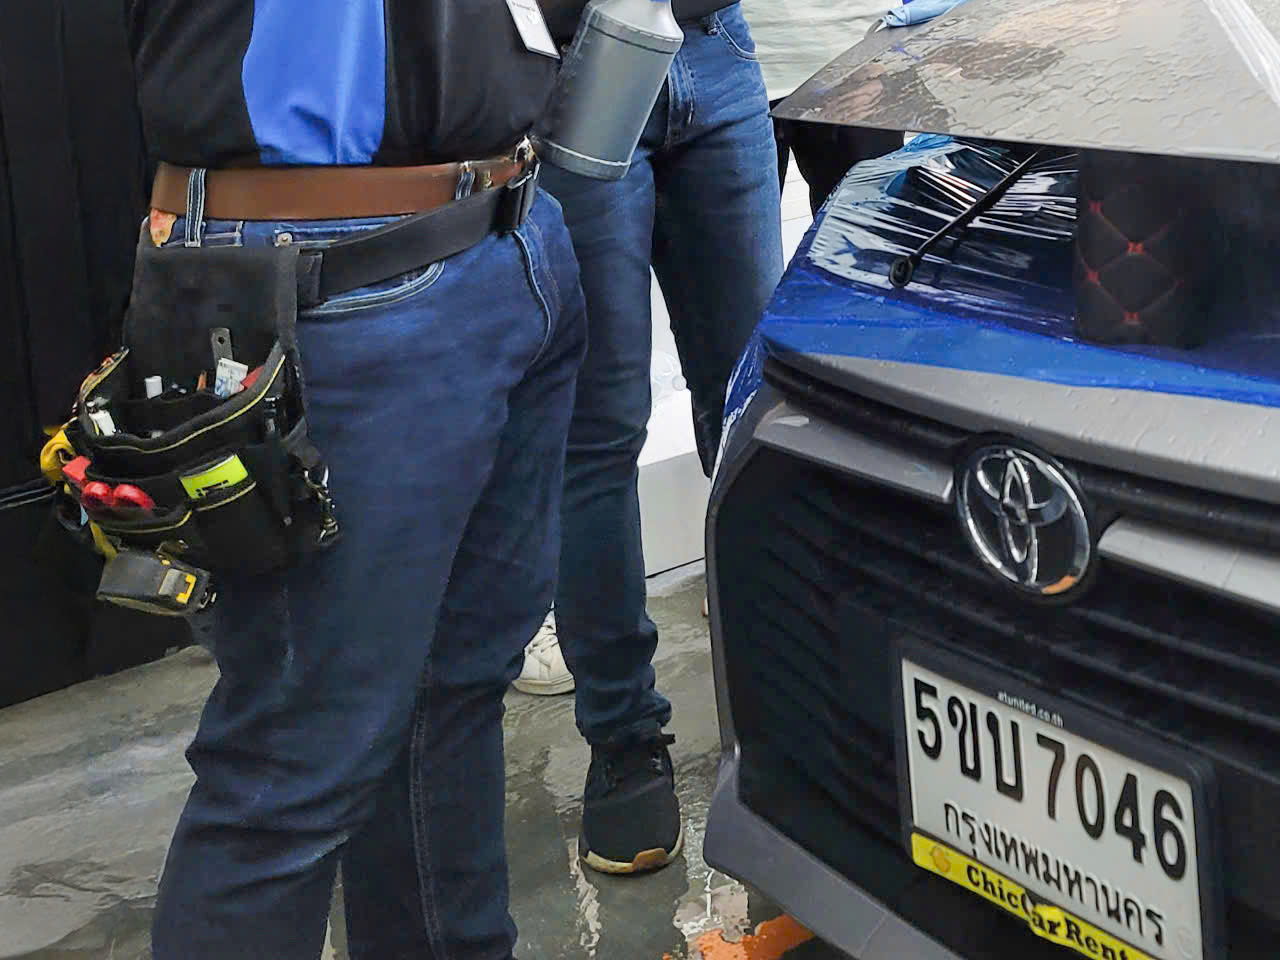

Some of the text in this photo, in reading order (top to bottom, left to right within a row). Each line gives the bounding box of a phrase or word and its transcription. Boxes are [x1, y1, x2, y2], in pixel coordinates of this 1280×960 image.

[943, 802, 1165, 947] กรุงเทพมหานคร
[1036, 733, 1187, 881] 7046
